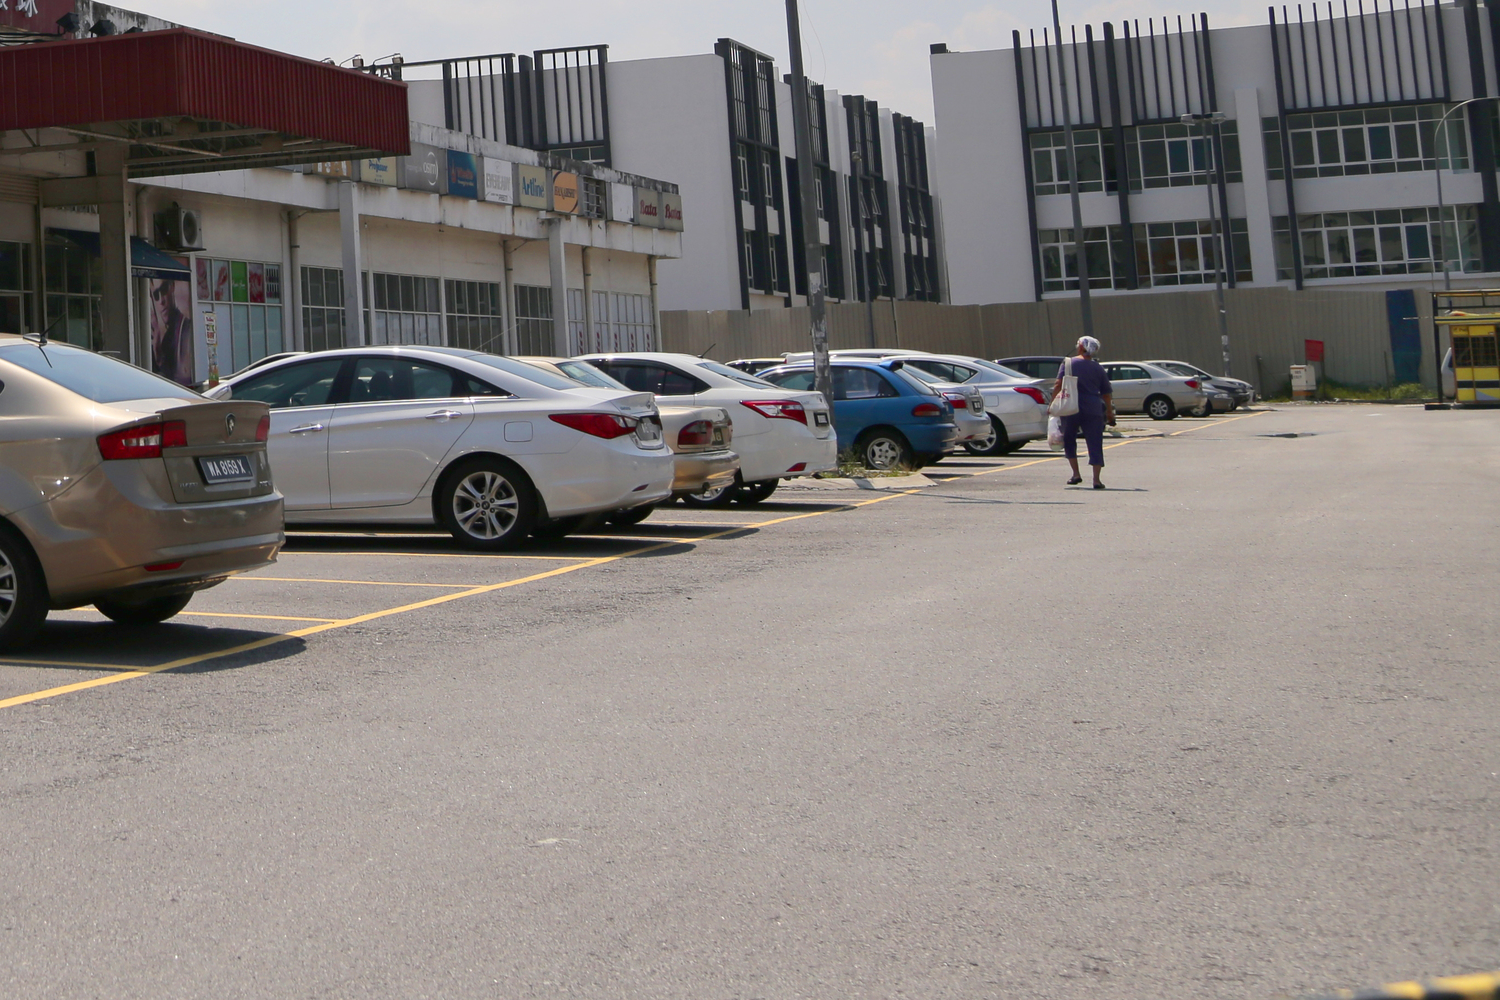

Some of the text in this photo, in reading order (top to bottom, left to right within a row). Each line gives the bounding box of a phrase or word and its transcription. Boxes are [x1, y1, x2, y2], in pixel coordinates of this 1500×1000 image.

[522, 176, 544, 198] Artline
[640, 199, 657, 217] Bata
[665, 203, 682, 221] Bata
[207, 459, 246, 477] WA 8159 X
